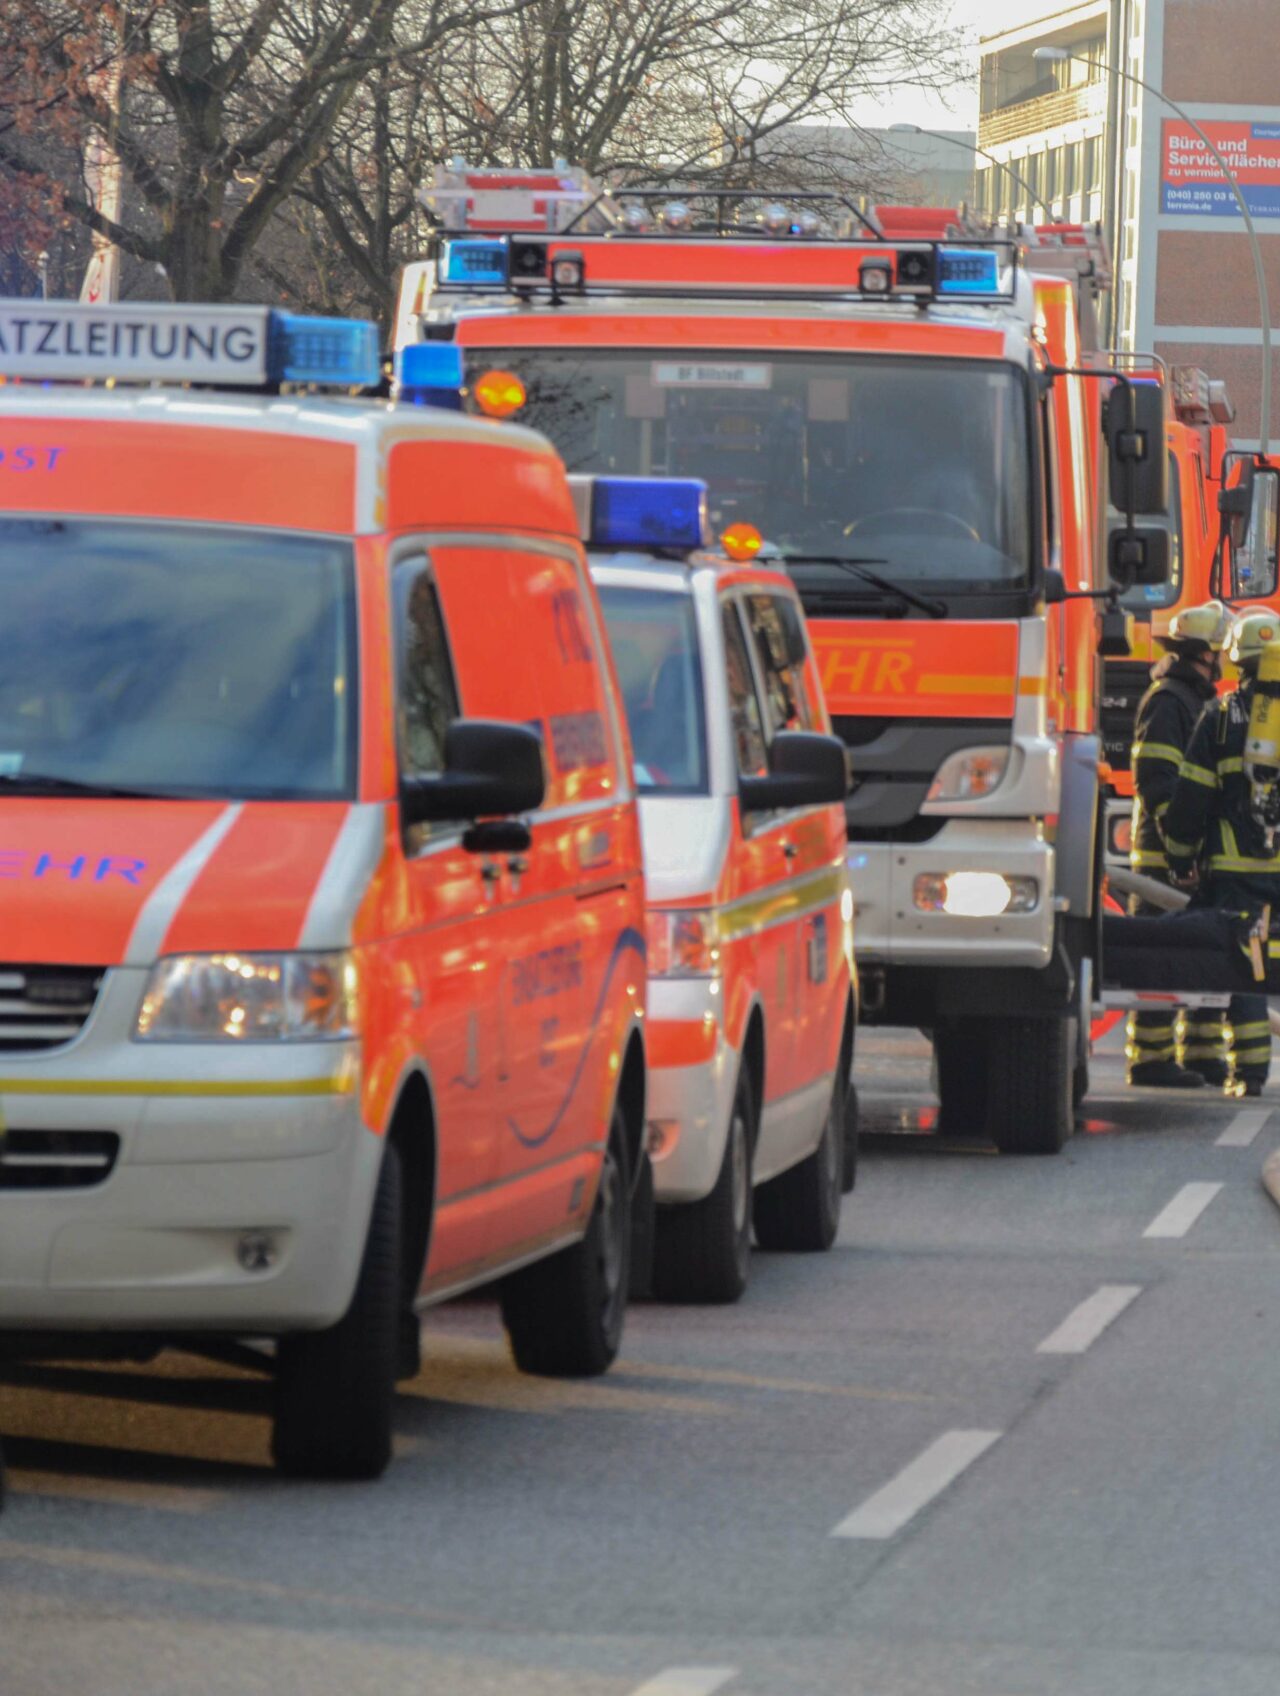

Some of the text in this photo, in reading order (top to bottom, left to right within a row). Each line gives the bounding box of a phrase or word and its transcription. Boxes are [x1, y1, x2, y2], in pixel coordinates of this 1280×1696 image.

[1217, 138, 1247, 152] und
[1168, 168, 1237, 178] zu vermietn
[1167, 190, 1192, 201] (040)
[1214, 192, 1226, 201] 03
[0, 447, 65, 472] ST
